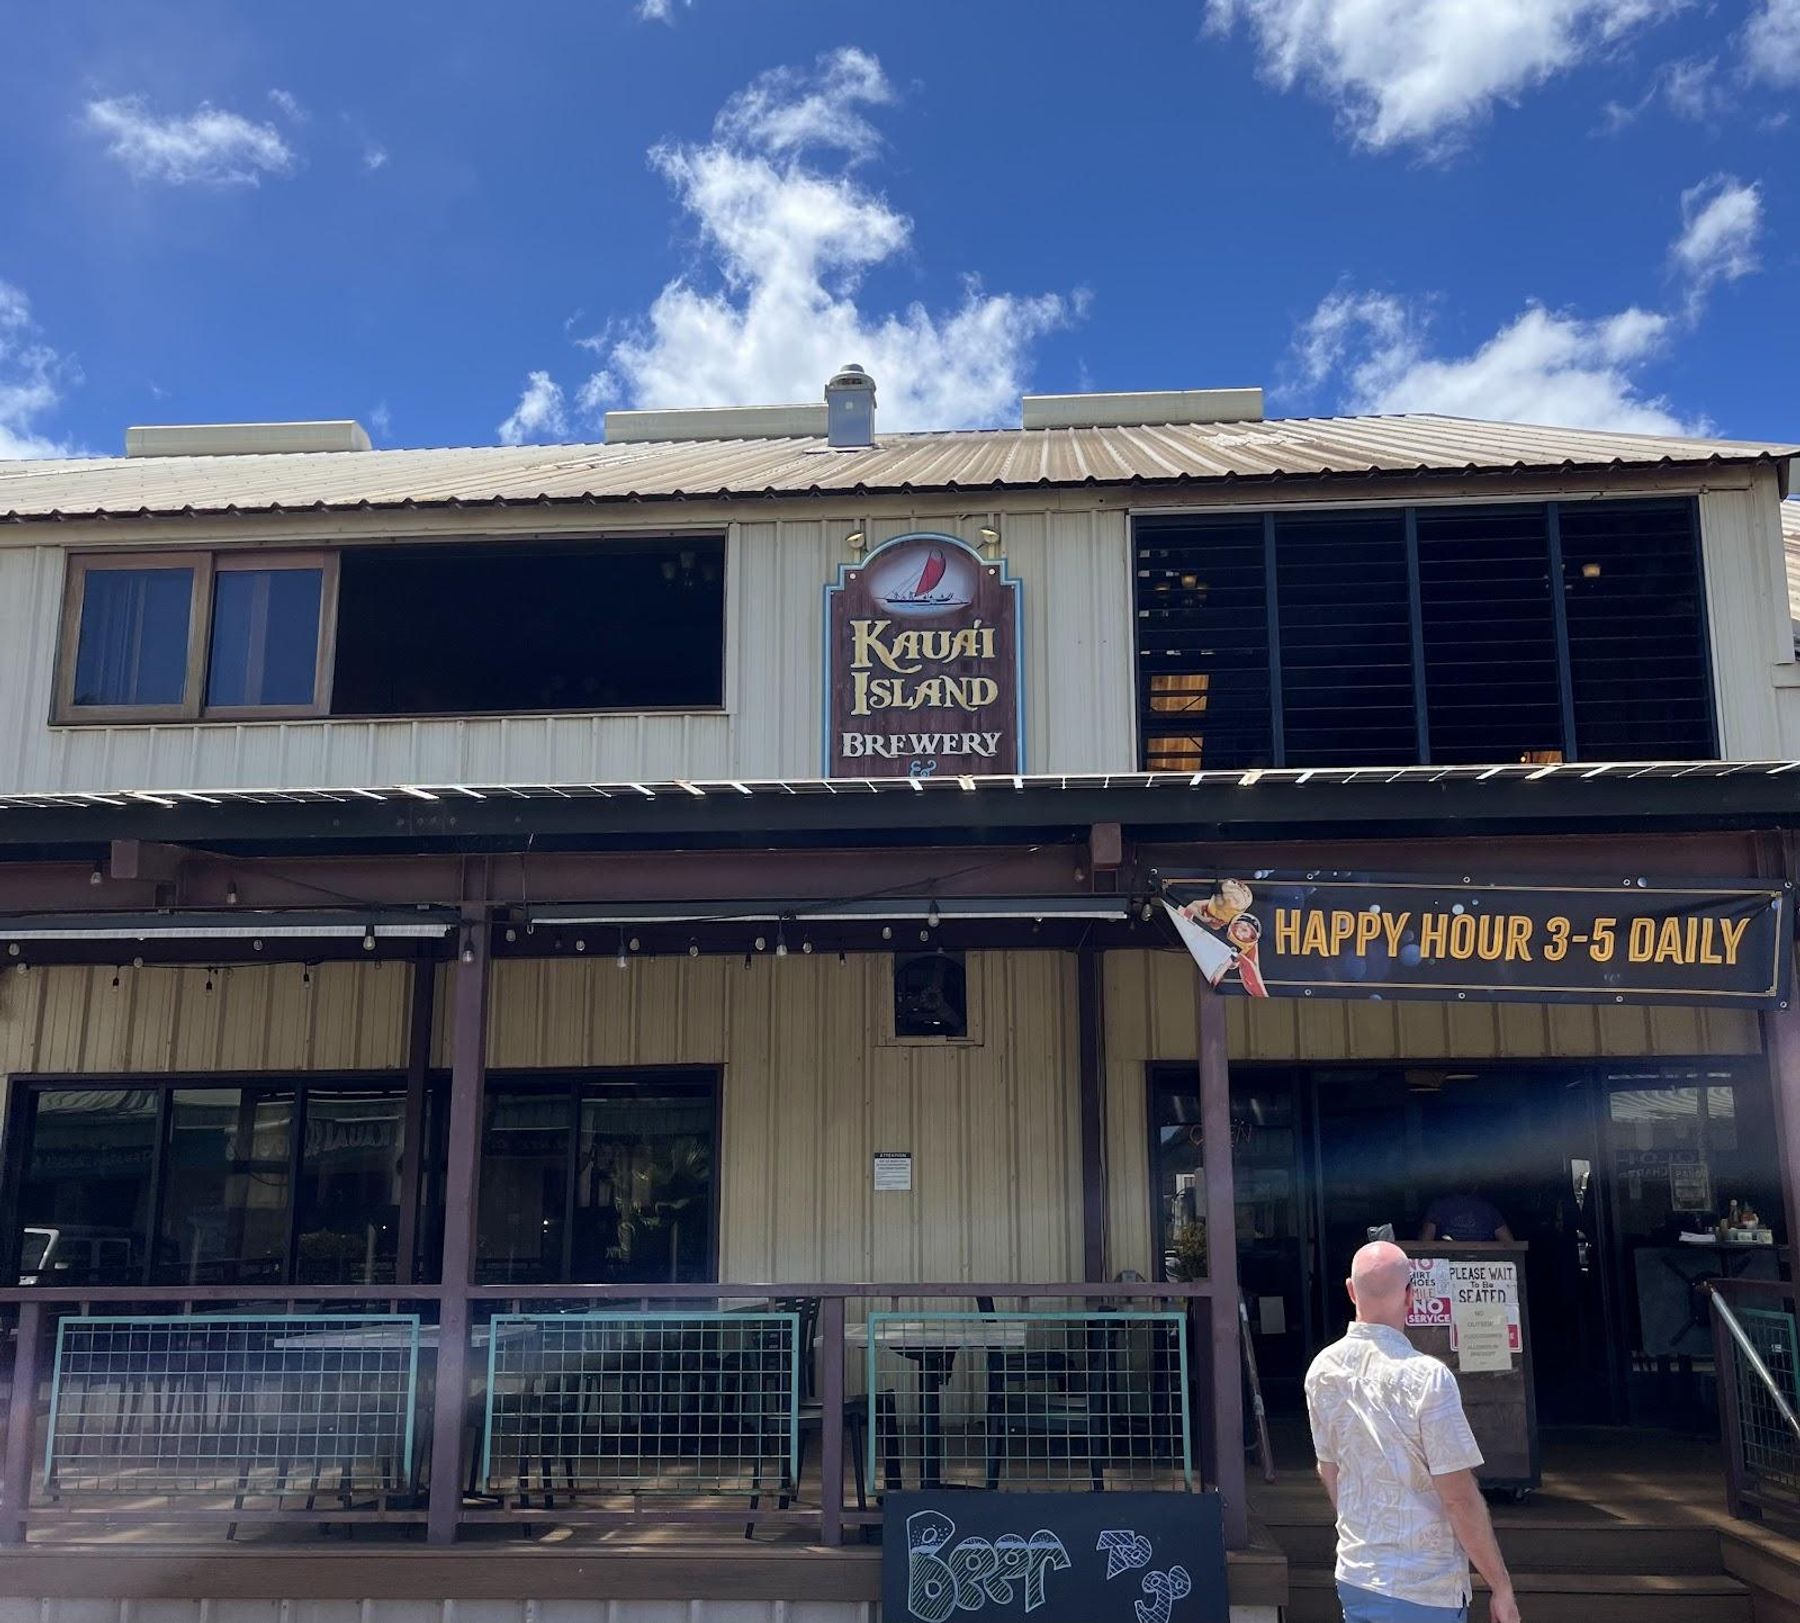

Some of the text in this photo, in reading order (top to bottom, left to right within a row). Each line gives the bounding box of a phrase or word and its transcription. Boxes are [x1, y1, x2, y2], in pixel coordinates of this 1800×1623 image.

[850, 671, 999, 716] ISLAND
[842, 732, 1002, 759] BREWERY
[909, 759, 938, 777] &
[1275, 908, 1751, 965] HAPPY HOUR 3-5 DAILY
[1449, 1267, 1513, 1280] PLEASE WAIT
[1410, 1279, 1436, 1287] HOES
[1412, 1287, 1435, 1298] MILE
[1459, 1289, 1506, 1303] SEATED
[1413, 1298, 1444, 1314] NO
[1408, 1314, 1451, 1323] SERVICE
[906, 1510, 1153, 1623] Beer To
